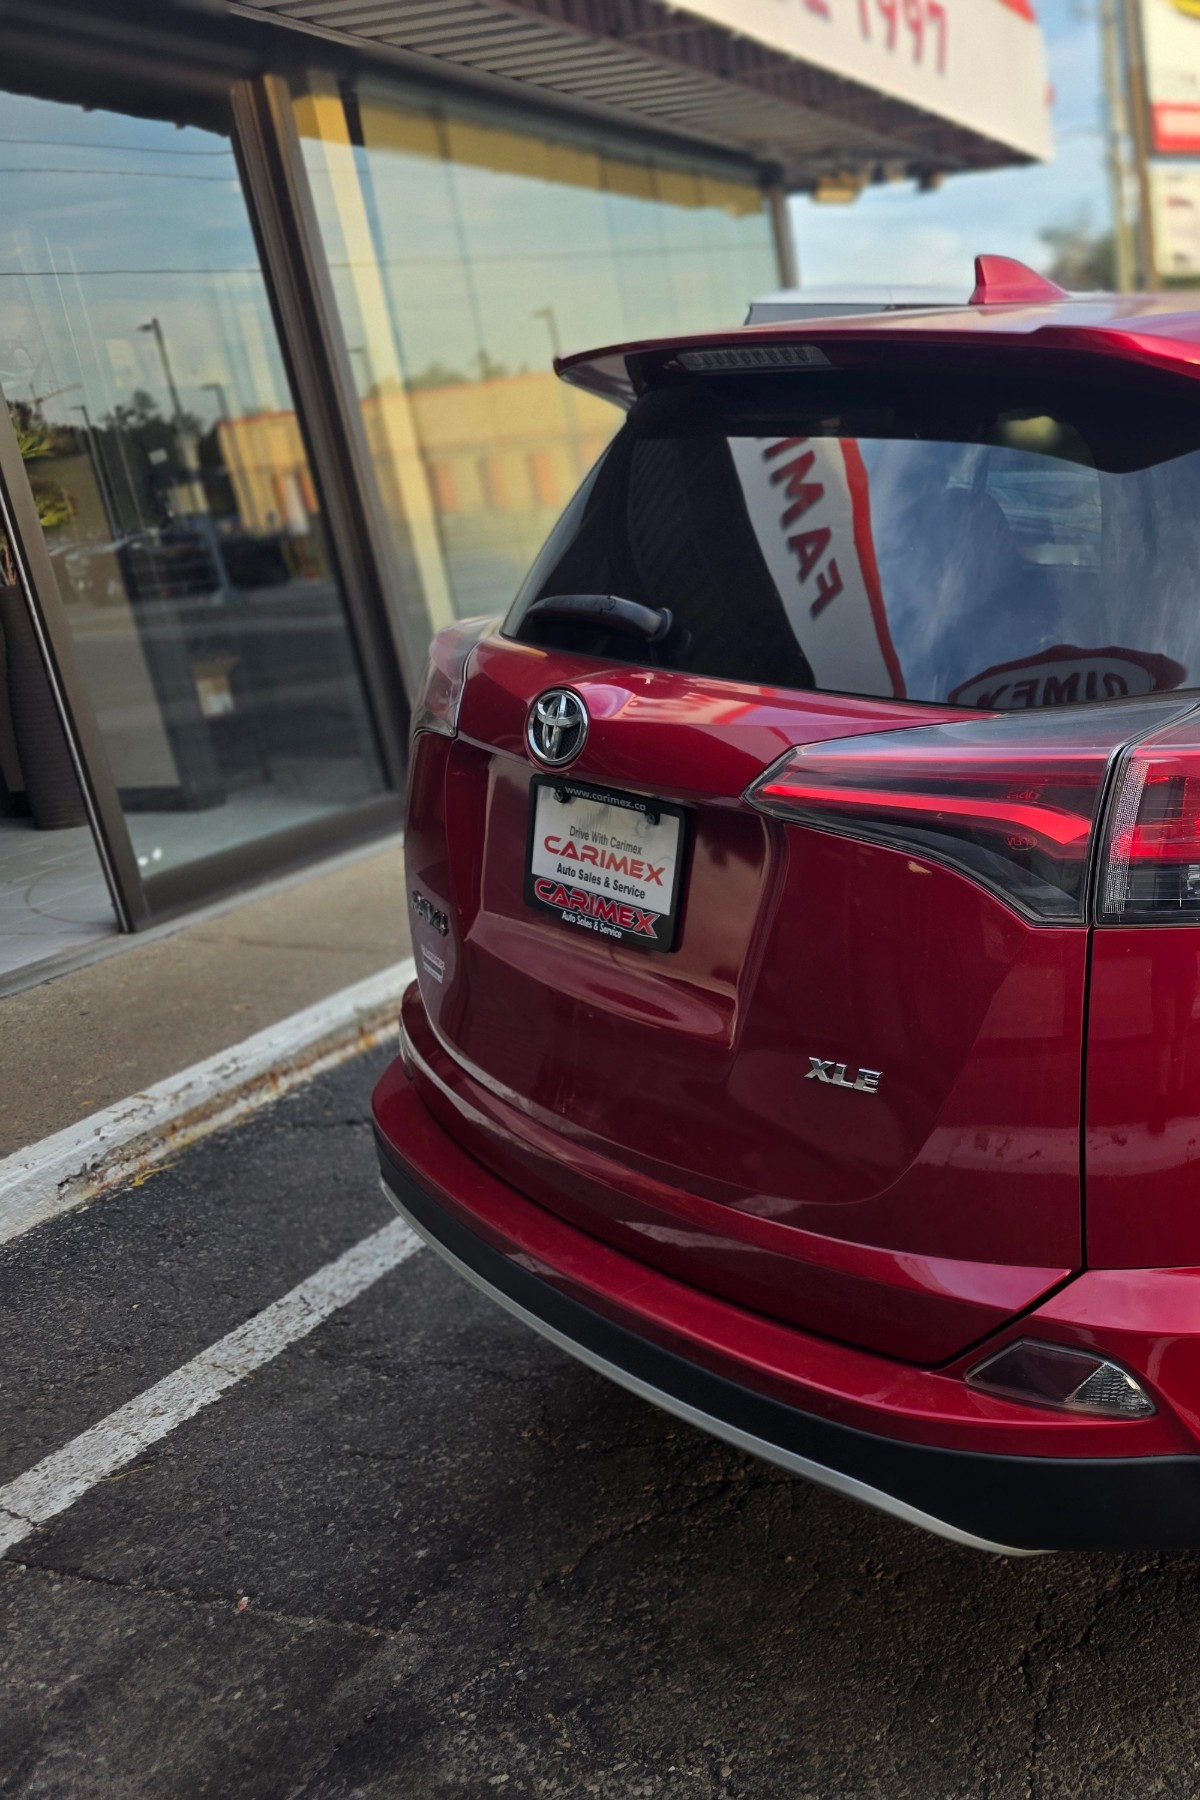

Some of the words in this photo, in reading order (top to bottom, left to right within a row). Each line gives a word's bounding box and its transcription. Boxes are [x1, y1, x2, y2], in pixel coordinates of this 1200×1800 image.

[564, 785, 647, 812] www.carimex.ca
[569, 825, 590, 841] Drive
[591, 831, 608, 847] With
[610, 836, 643, 856] Carimex
[543, 835, 666, 887] CARIMEX
[556, 862, 576, 878] Auto
[578, 868, 602, 886] Sales
[604, 876, 610, 889] &
[612, 880, 646, 900] Service
[534, 877, 661, 939] CARIMEX
[561, 910, 576, 924] Auto
[576, 915, 593, 929] Sales
[593, 921, 599, 931] &
[600, 924, 623, 939] Service
[803, 1056, 884, 1094] XLE
